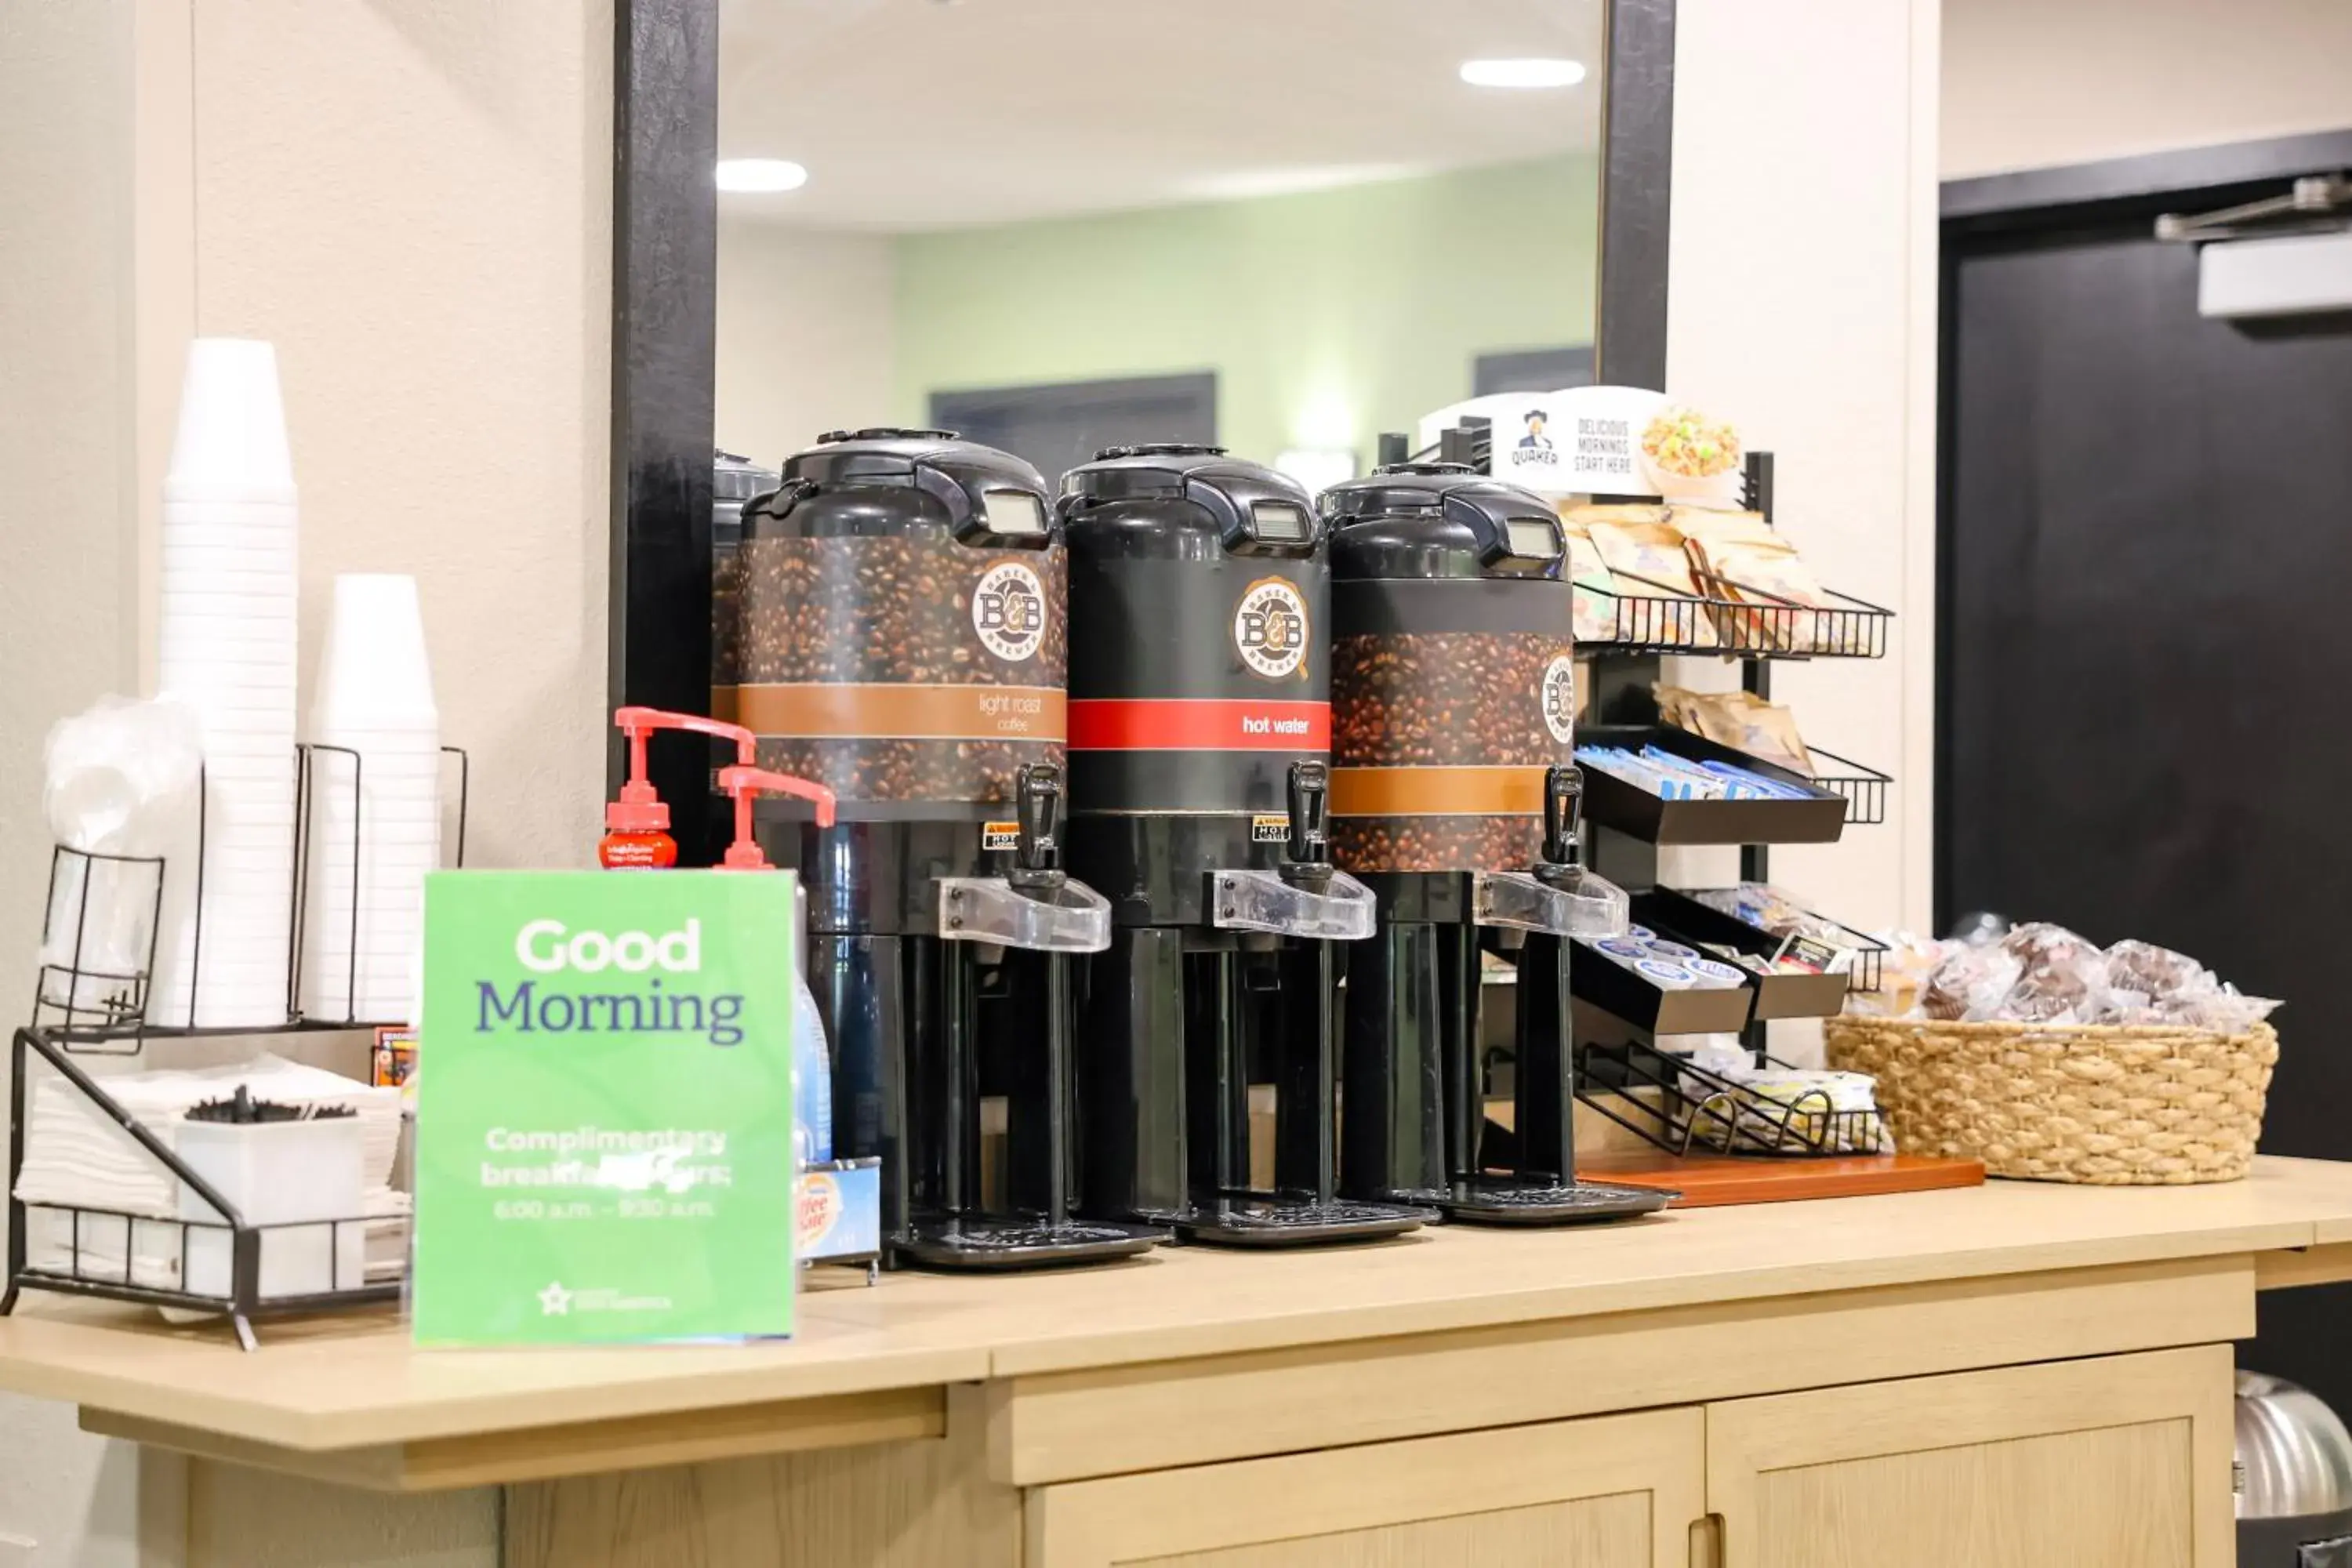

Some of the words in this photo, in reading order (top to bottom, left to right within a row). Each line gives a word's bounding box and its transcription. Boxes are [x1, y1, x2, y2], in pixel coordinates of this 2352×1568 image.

[1578, 418, 1628, 436] DELICIOUS
[1578, 437, 1629, 455] MORNINGS
[1512, 449, 1558, 466] QUAKER
[1575, 456, 1604, 472] START
[1607, 458, 1631, 474] HERE
[978, 593, 1041, 631] B&B
[1241, 612, 1301, 648] B&B
[979, 693, 1010, 715] light
[1012, 696, 1041, 713] roast
[997, 717, 1029, 732] coffee
[1243, 716, 1270, 733] hot
[1273, 717, 1308, 734] water
[515, 918, 701, 973] Good
[474, 978, 745, 1046] Morning
[485, 1125, 727, 1156] Complimentary
[548, 1203, 593, 1218] a.m.
[669, 1201, 716, 1218] a.m.
